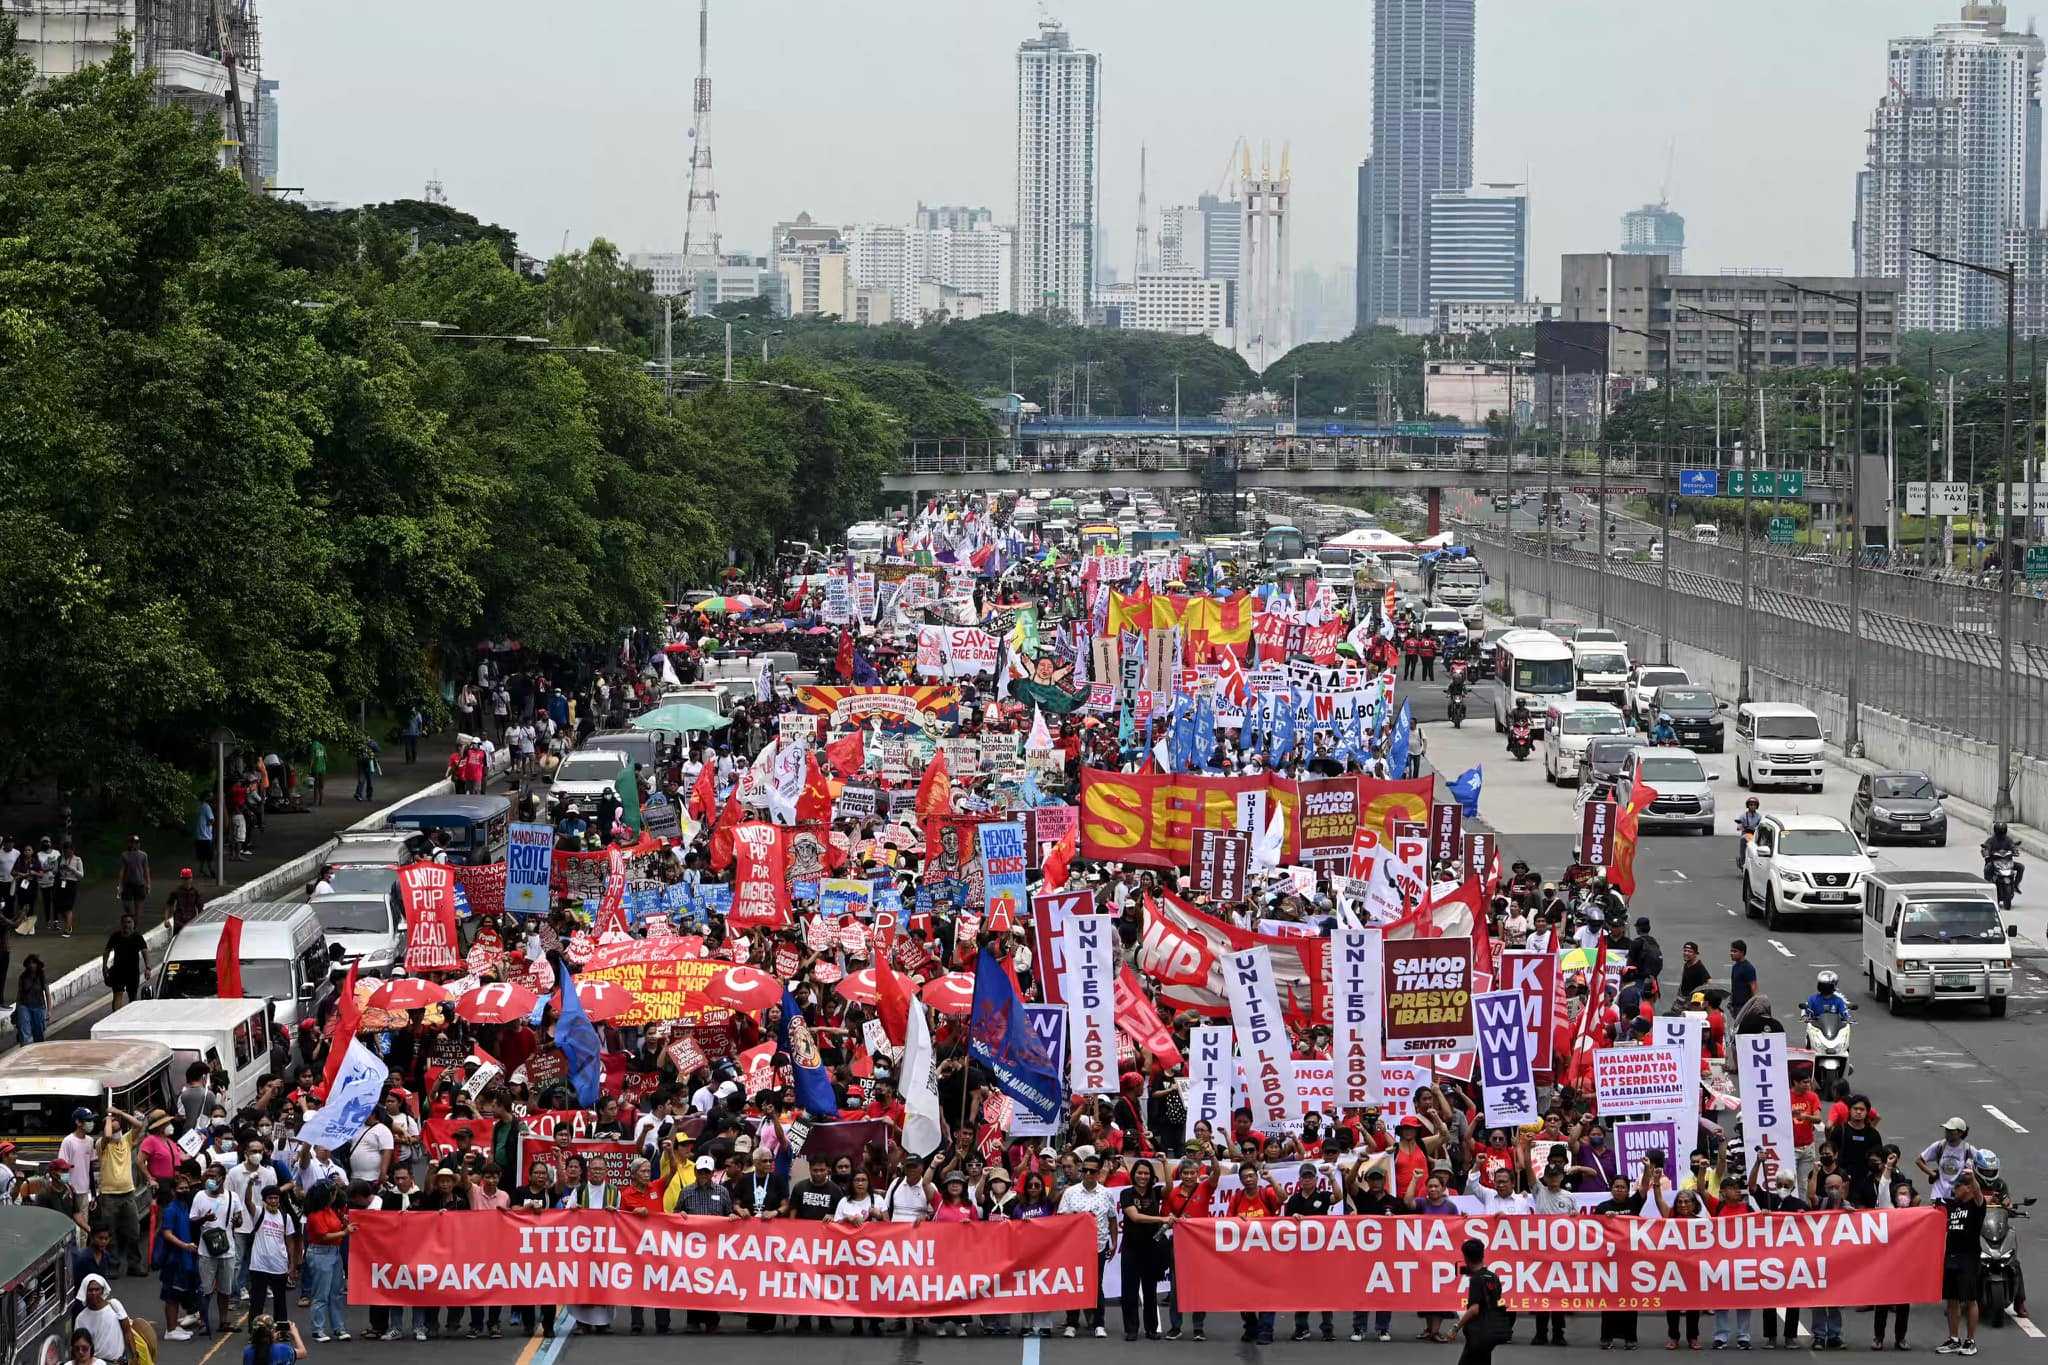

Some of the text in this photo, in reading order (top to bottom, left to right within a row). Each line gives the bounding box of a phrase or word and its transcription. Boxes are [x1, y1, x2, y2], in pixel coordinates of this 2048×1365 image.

[1737, 473, 1758, 482] BS
[1944, 485, 1965, 493] AUV
[1944, 493, 1967, 501] TAXI
[952, 629, 1000, 649] SAVE
[952, 649, 970, 660] RICE
[1305, 791, 1355, 804] SAHOD
[1085, 782, 1428, 856] SENTO
[1247, 794, 1256, 832] UNITED
[1306, 803, 1353, 816] ITAAS!
[1302, 814, 1356, 828] PRESYO
[983, 828, 1020, 846] MENTAL
[1306, 826, 1353, 840] IBABA!
[1440, 806, 1453, 859] SENTRO
[1591, 803, 1606, 864] SENTRO
[510, 845, 550, 871] ROTC
[985, 843, 1022, 859] HEALTH
[1200, 831, 1213, 889] SENTRO
[1312, 846, 1349, 856] SENTRO
[751, 864, 770, 879] FOR
[988, 858, 1024, 874] CRISIS
[1221, 840, 1236, 899] SENTRO
[1473, 835, 1486, 894] SENT
[405, 868, 446, 888] UNITED
[412, 889, 444, 910] PUP
[741, 882, 775, 901] HIGHER
[739, 901, 776, 917] WAGES
[411, 922, 447, 946] ACAD
[1141, 912, 1201, 979] MP
[405, 946, 457, 968] FREEDOM
[1392, 956, 1466, 975] SAHOD
[1396, 971, 1463, 991] ITAAS!
[1078, 920, 1104, 1089] UNITED LABOR
[1389, 990, 1468, 1009] PRESYO
[703, 1011, 728, 1022] STAND
[1345, 934, 1367, 1102] UNITED LABOR
[1395, 1007, 1463, 1026] IBABA!
[1235, 955, 1287, 1121] UNITED LABOR
[1403, 1038, 1457, 1051] SENTRO
[1479, 999, 1520, 1081] WWU
[1600, 1052, 1672, 1064] MALAWAK NA
[1201, 1032, 1218, 1121] UNITED
[1600, 1062, 1677, 1076] KARAPATAN
[1600, 1073, 1677, 1088] AT SERBISYO
[1751, 1039, 1778, 1128] UNITED
[1611, 1084, 1683, 1097] KABABAIHAN!
[1625, 1130, 1669, 1150] UNION
[803, 1191, 831, 1201] SERVE
[803, 1199, 831, 1208] PEOPLE
[1215, 1211, 1889, 1257] DAGDAG NA SAHOD, KABUHAYAN
[519, 1226, 936, 1267] ITIGIL ANG KARAHASAN!
[371, 1261, 1086, 1303] KAPAKANAN NG MASA, HINDI MAHARLIKA!
[1365, 1261, 1419, 1293] AT
[1631, 1260, 1688, 1294] SA
[1699, 1256, 1828, 1293] MESA!
[1461, 1297, 1664, 1309] PPLE'S SONA 2023
